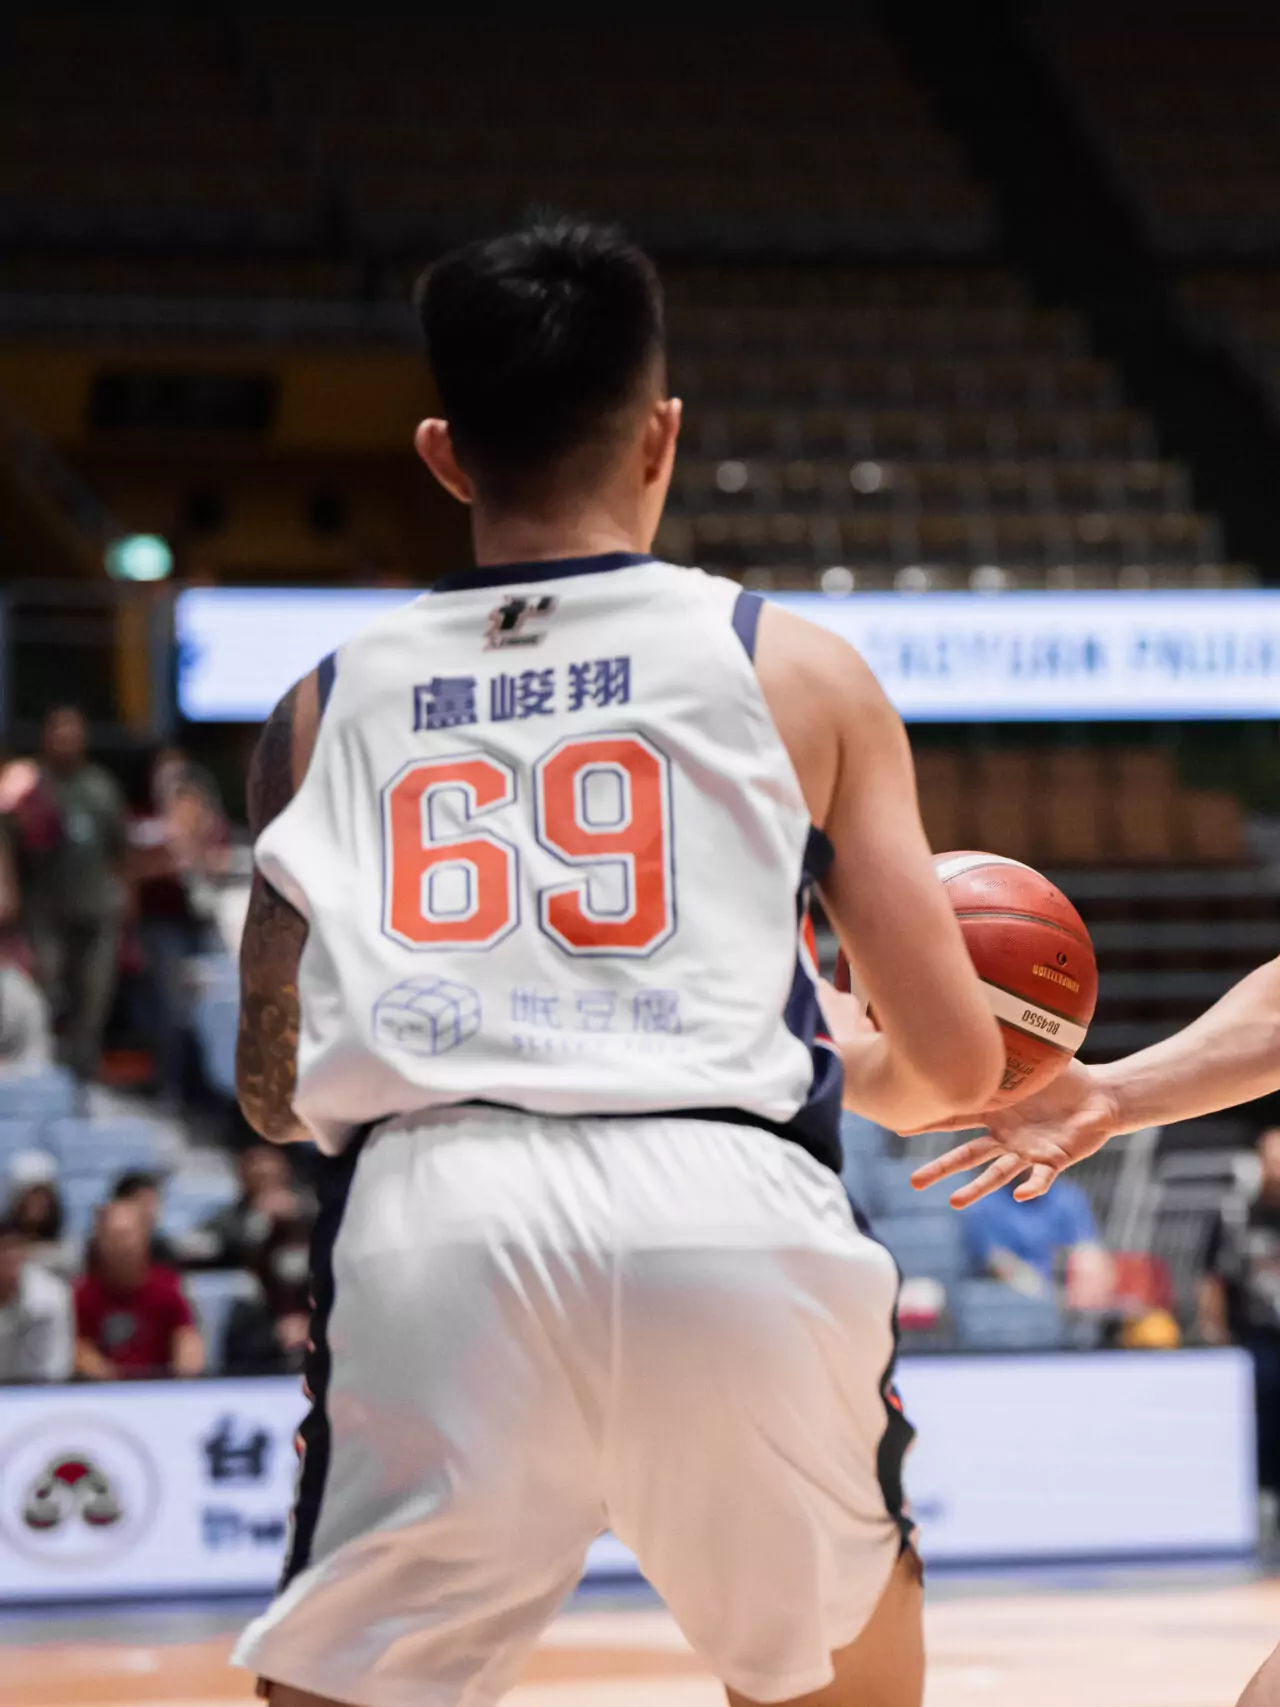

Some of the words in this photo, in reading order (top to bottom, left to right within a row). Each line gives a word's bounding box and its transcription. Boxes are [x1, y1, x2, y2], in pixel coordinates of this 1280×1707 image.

[413, 656, 631, 732] 盧峻翔
[381, 729, 678, 959] 69
[1021, 1008, 1061, 1036] BG4550
